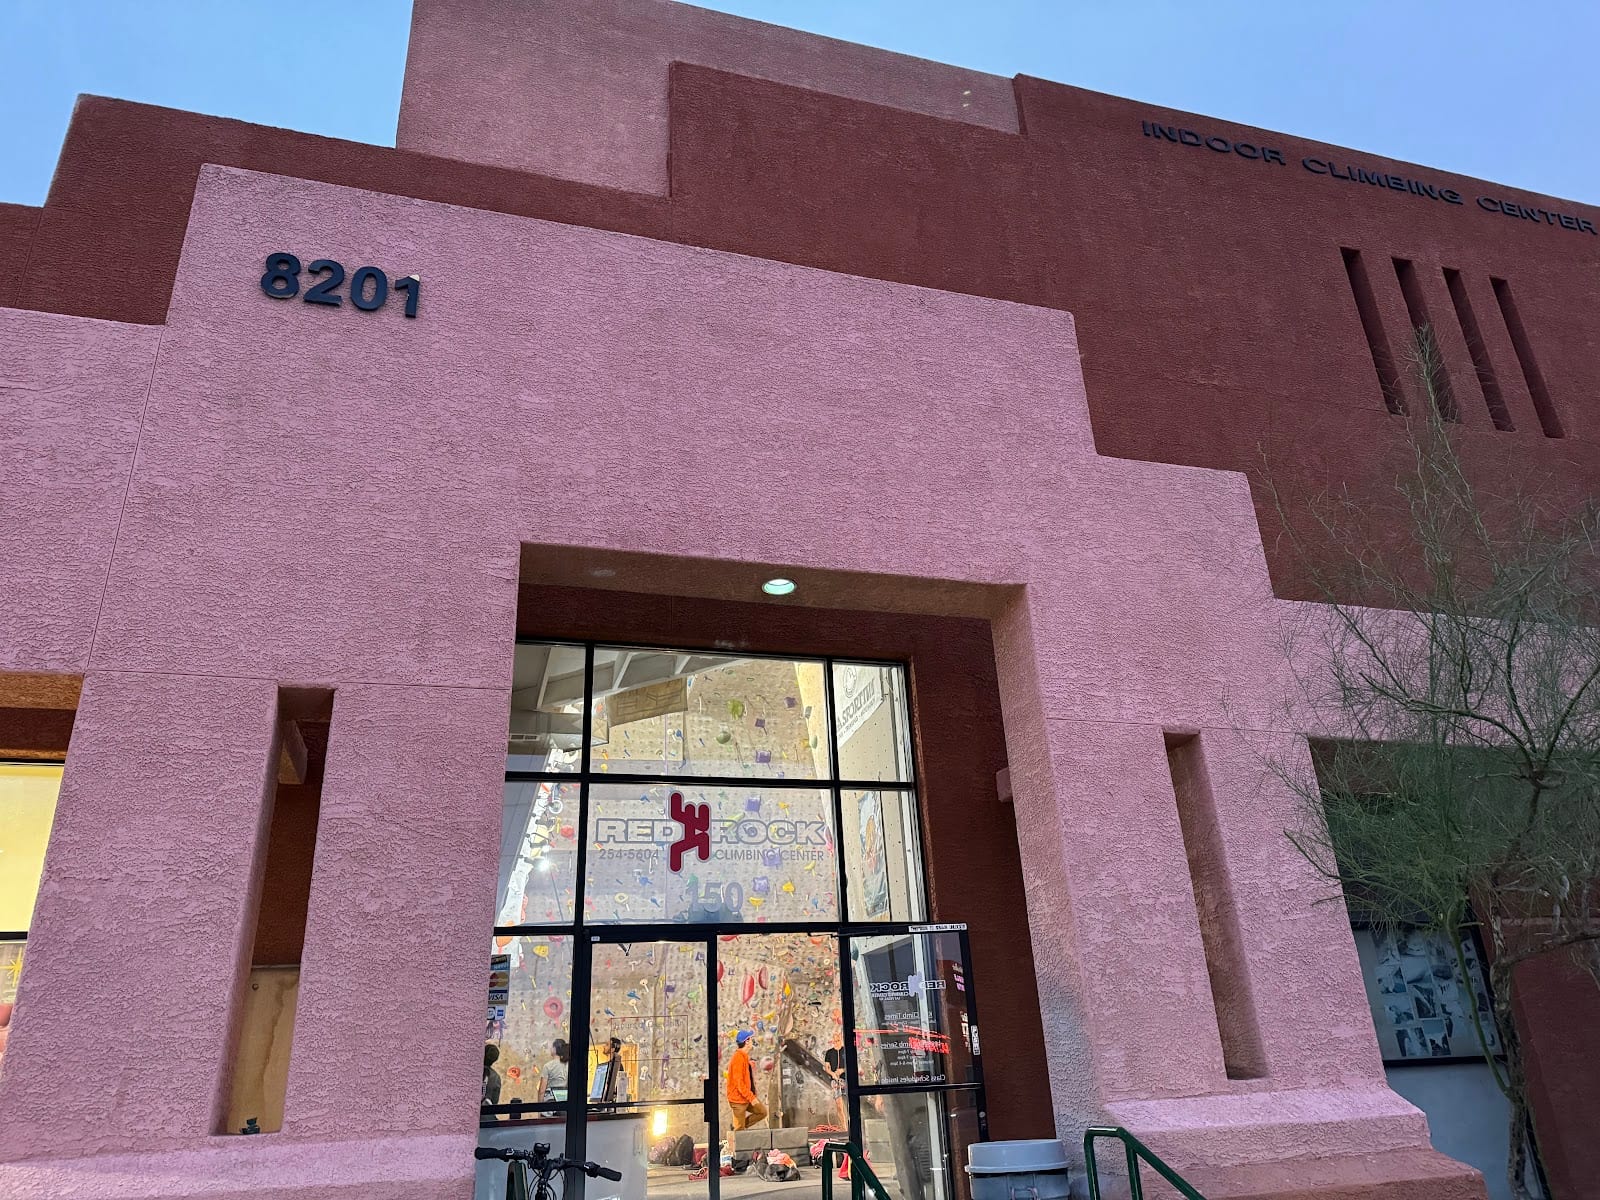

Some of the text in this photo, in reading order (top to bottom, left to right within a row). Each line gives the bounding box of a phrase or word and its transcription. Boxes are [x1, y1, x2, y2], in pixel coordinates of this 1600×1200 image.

[1142, 119, 1598, 235] INDOOR CLIMBING CENTER
[261, 252, 421, 318] 8201
[596, 818, 827, 846] RED ROCK
[715, 849, 824, 861] CLIMBING CENTER
[686, 878, 744, 913] 150
